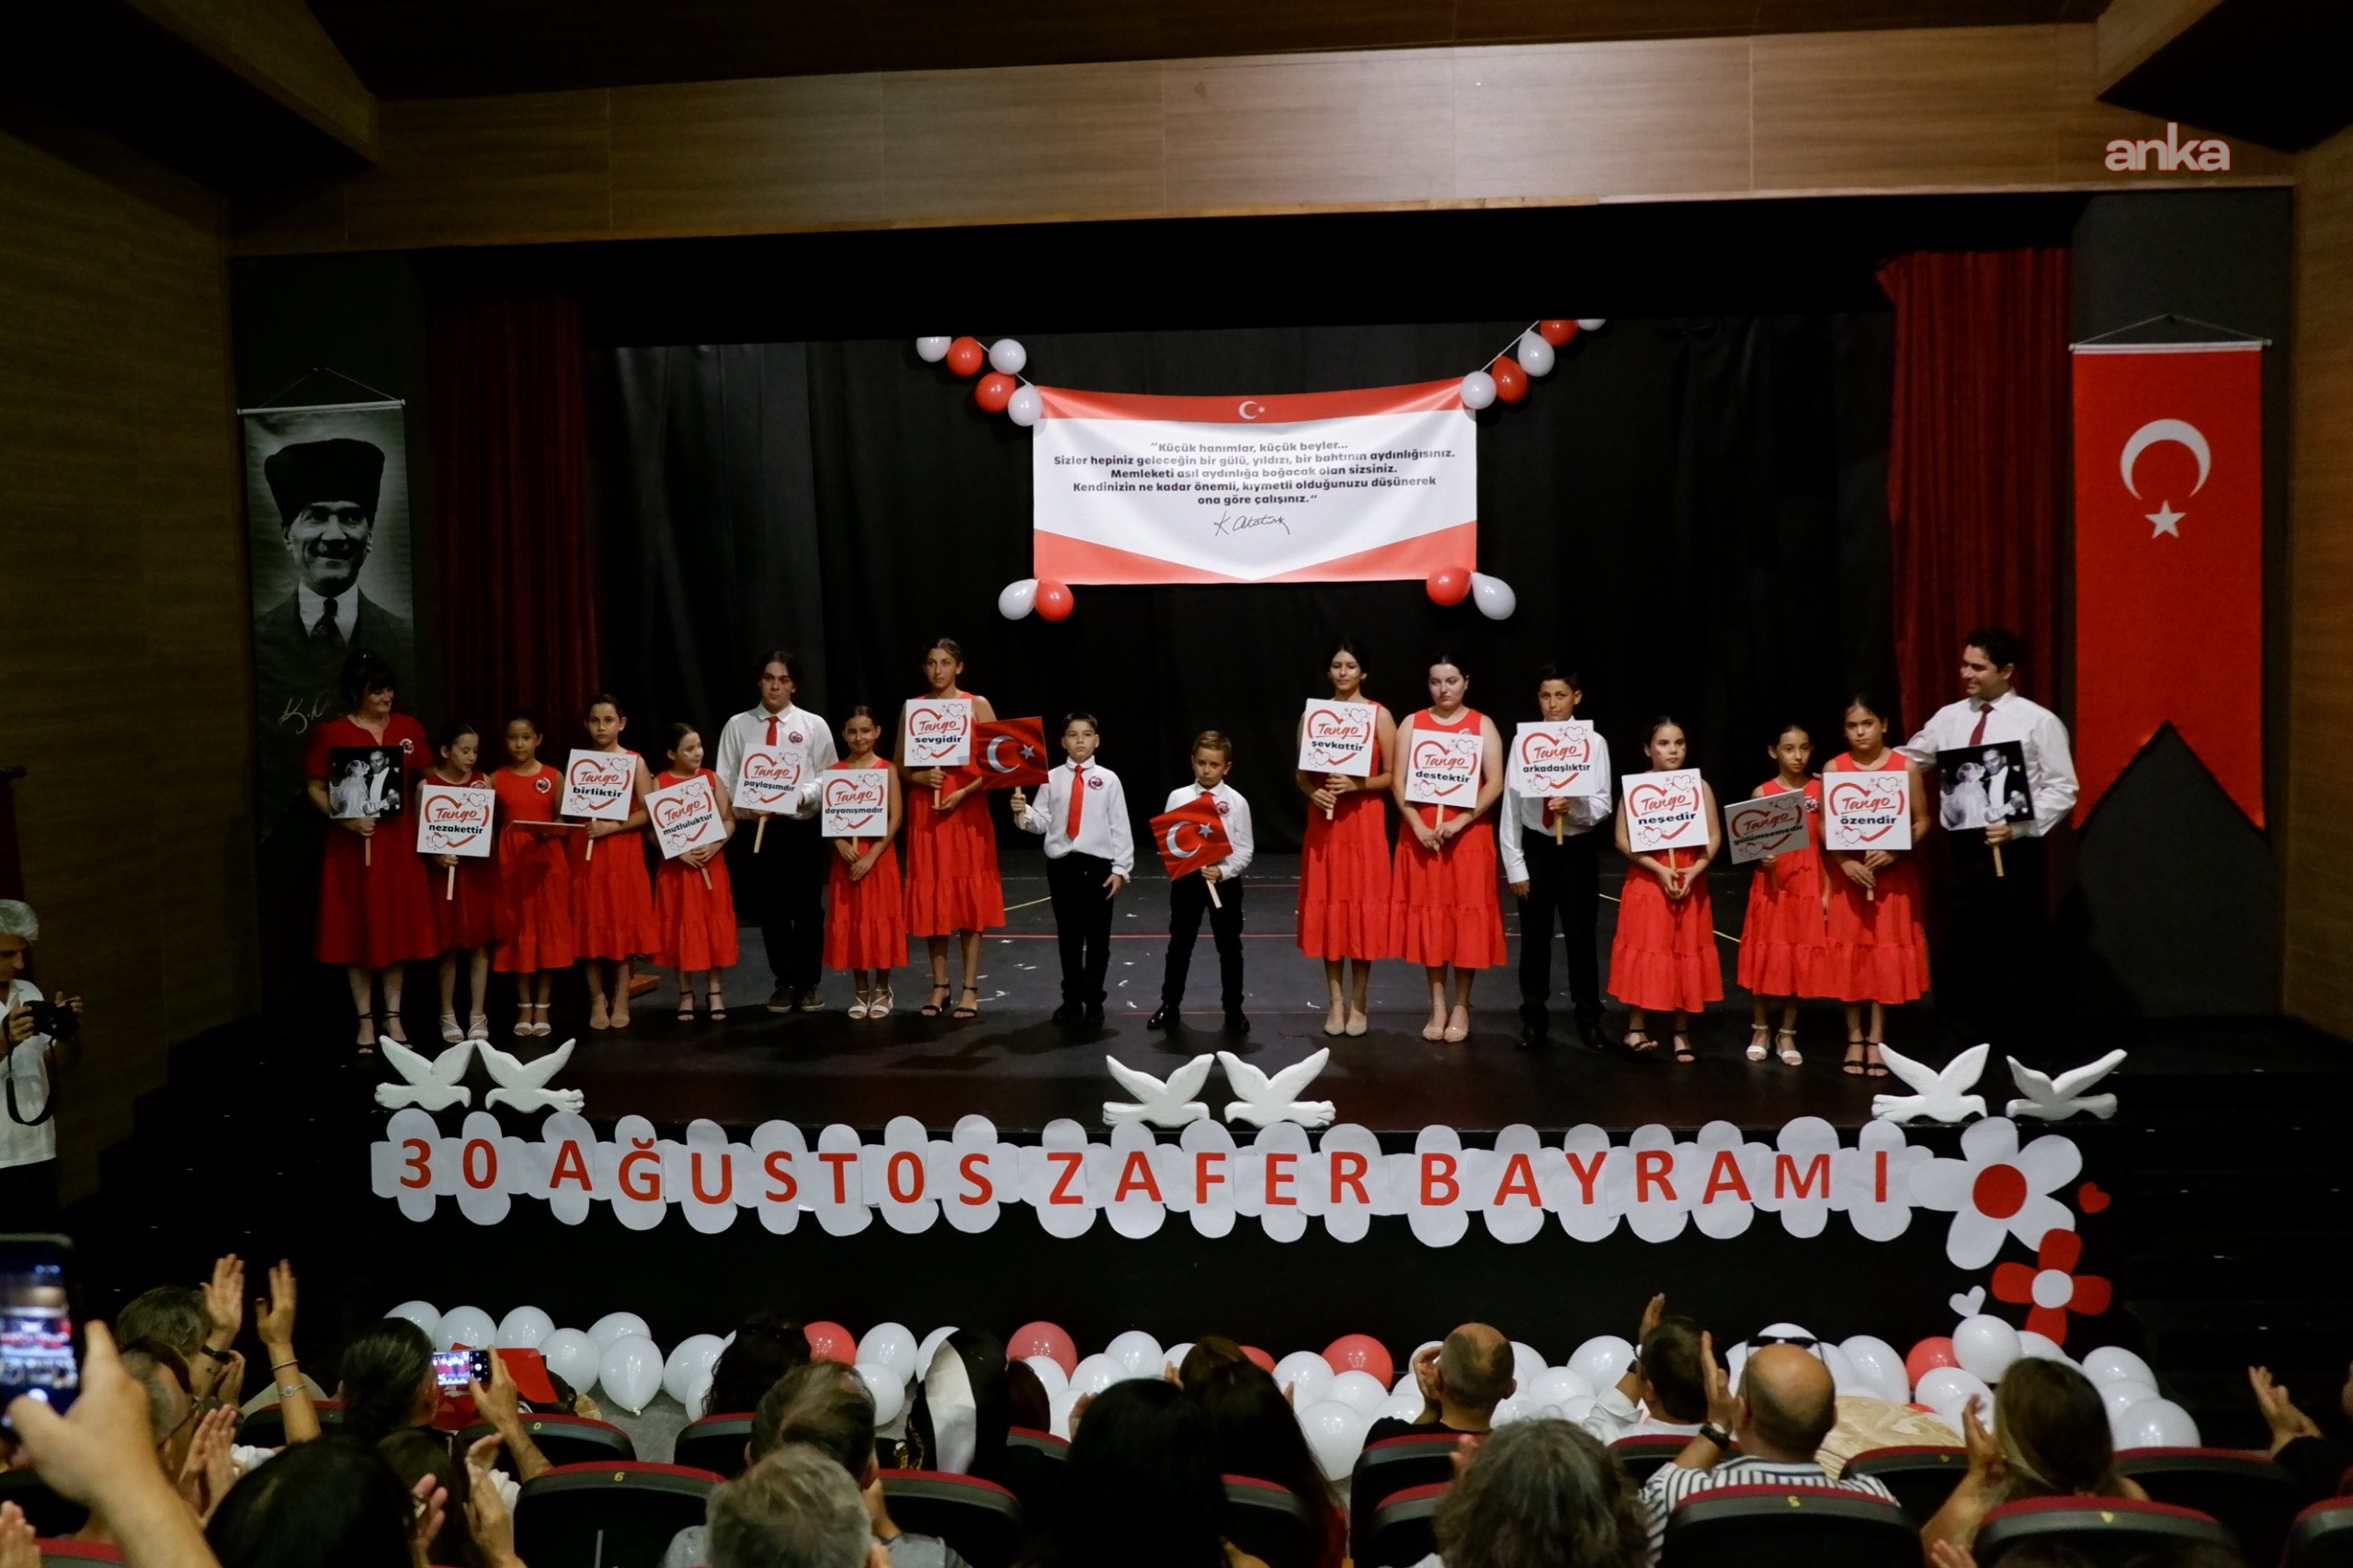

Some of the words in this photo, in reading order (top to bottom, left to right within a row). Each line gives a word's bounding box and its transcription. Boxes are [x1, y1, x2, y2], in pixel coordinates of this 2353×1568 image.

[1199, 443, 1256, 454] hanımlar,
[1259, 442, 1297, 453] küçük
[1053, 456, 1088, 466] Sizler
[1090, 455, 1134, 468] hepiniz
[1136, 455, 1197, 468] geleceğin
[1199, 455, 1217, 466] bir
[1219, 455, 1250, 468] gülü,
[1253, 455, 1293, 467] yıldızı,
[1295, 454, 1313, 464] bir
[1314, 452, 1368, 463] bahtının
[1370, 449, 1456, 462] aydınlığısınız.
[1110, 469, 1175, 479] Memleketi
[1176, 469, 1199, 479] asıl
[1201, 468, 1259, 481] aydınlığa
[1262, 467, 1316, 479] boğacak
[1318, 466, 1347, 476] olan
[1348, 463, 1398, 475] sizsiniz.
[1073, 482, 1136, 492] Kendinizin
[1138, 483, 1154, 492] ne
[1156, 481, 1191, 492] kadar
[1194, 480, 1240, 492] önemli,
[1243, 479, 1293, 493] kıymetli
[1295, 477, 1369, 491] olduğunuzu
[1370, 475, 1437, 488] düşünerek
[1198, 495, 1221, 506] ona
[1223, 494, 1252, 506] göre
[919, 721, 957, 734] Tango
[1318, 723, 1358, 740] Tango
[915, 735, 962, 744] sevgidir
[1533, 745, 1576, 761] Tango
[1425, 754, 1465, 771] Tango
[1522, 764, 1591, 773] arkadaşlıktır
[581, 772, 620, 786] Tango
[754, 766, 790, 780] Tango
[1415, 770, 1471, 784] destektir
[573, 786, 623, 798] birliktir
[744, 779, 795, 792] paylaşımdır
[835, 790, 872, 804] Tango
[1642, 794, 1686, 812] Tango
[664, 800, 700, 822] Tango
[824, 807, 883, 815] dayanışmadır
[1842, 797, 1890, 813] Tango
[436, 808, 477, 824] Tango
[1638, 812, 1697, 825] neşedir
[1743, 812, 1789, 832] Tango
[1840, 814, 1897, 825] özendir
[428, 824, 483, 835] nezakettir
[663, 813, 713, 835] mutluluktur
[1733, 825, 1803, 846] gülümsemedir
[399, 1138, 498, 1189] 30
[1047, 1151, 1370, 1206] ZAFER
[1420, 1150, 1888, 1207] BAYRAMI
[613, 1471, 626, 1483] 6
